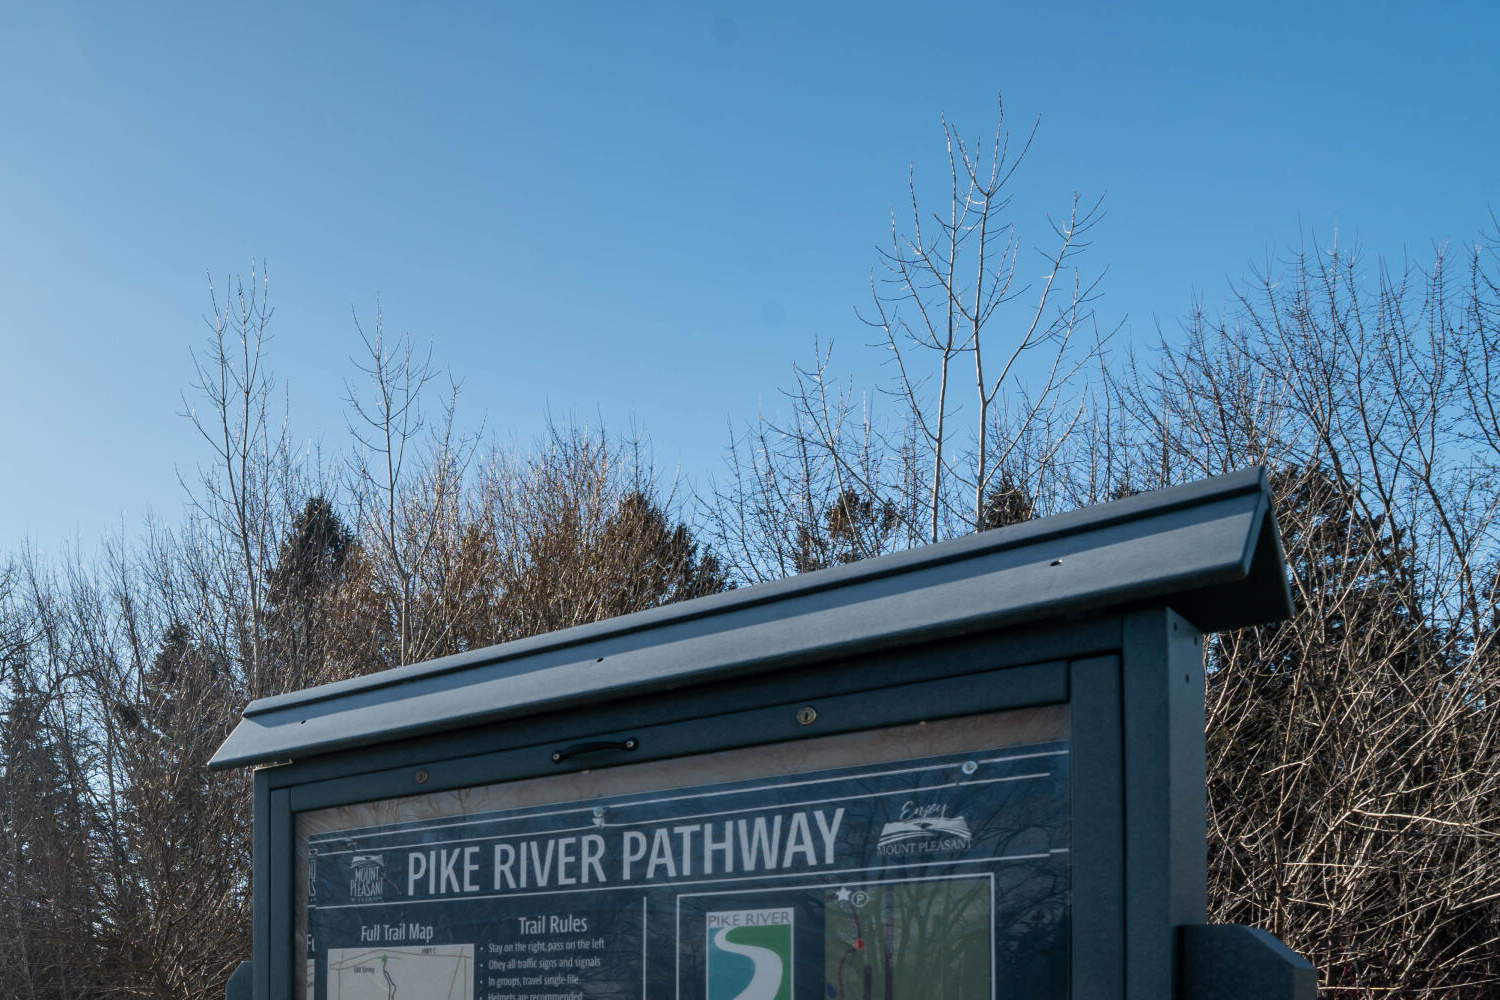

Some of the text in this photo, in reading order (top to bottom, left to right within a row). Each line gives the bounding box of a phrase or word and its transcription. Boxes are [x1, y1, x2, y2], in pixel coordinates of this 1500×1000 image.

[900, 801, 950, 820] Enjoy
[408, 808, 845, 896] PIKE RIVER PATHWAY
[877, 839, 972, 856] MOUNT PLEASANT
[355, 866, 380, 881] MOUNT
[351, 878, 383, 896] PLEASANT
[518, 914, 587, 935] Trail Rules
[708, 911, 791, 926] PIKE RIVER
[361, 923, 434, 942] Full Trail Map
[489, 943, 502, 954] Stay
[505, 944, 513, 952] on
[515, 942, 526, 951] the
[548, 943, 564, 952] pass
[566, 942, 575, 950] on
[578, 939, 590, 949] the
[592, 938, 604, 949] left
[488, 956, 601, 971] Obey all traffic signs and signals
[489, 976, 495, 985] In
[523, 976, 542, 985] travel
